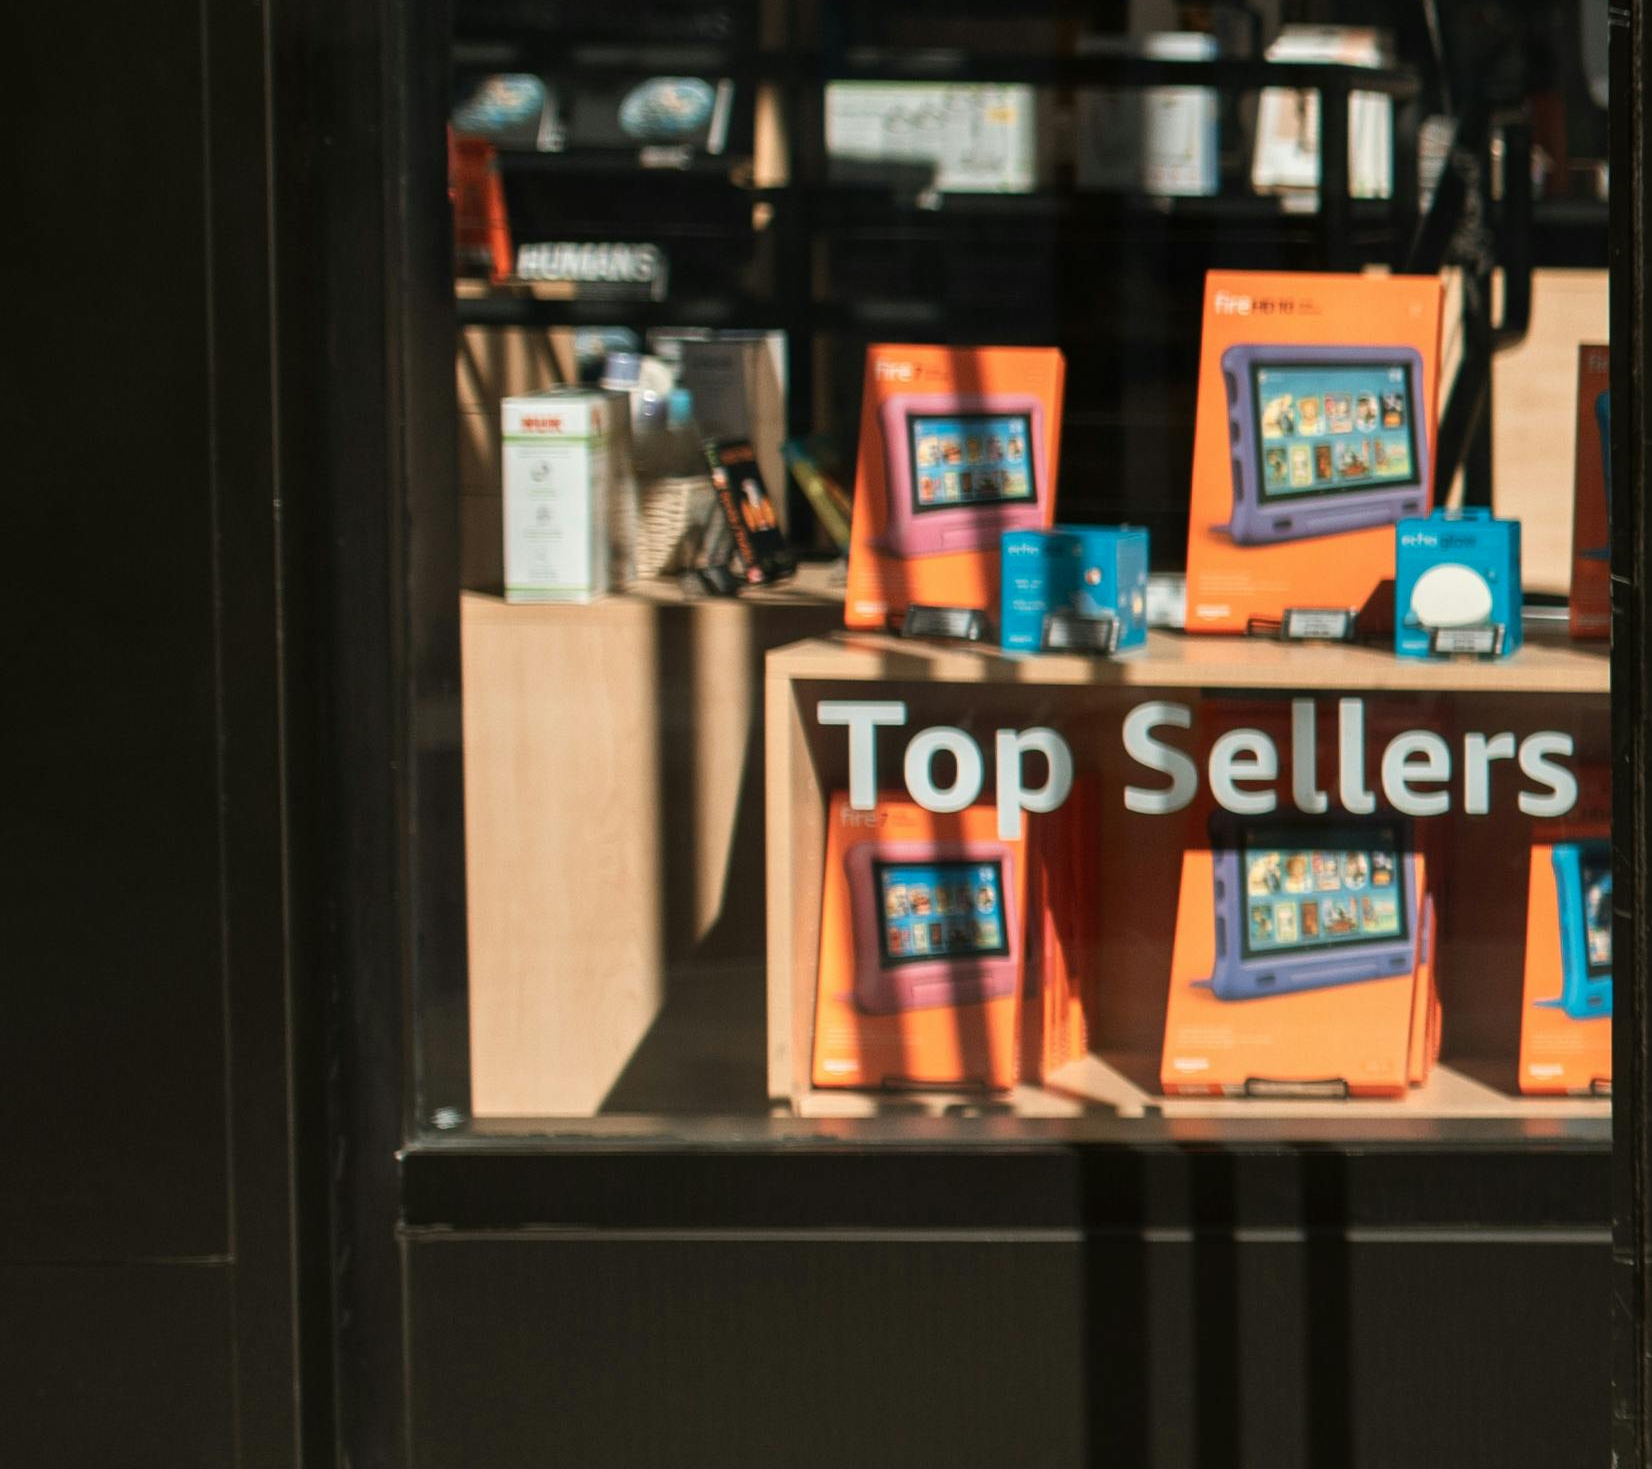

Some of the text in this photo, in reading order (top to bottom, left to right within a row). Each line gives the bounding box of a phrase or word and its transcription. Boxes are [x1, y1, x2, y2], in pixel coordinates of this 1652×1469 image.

[518, 242, 659, 281] HUMANS
[1215, 290, 1252, 315] fire
[876, 360, 913, 382] fire
[816, 697, 1580, 840] Top Sellers
